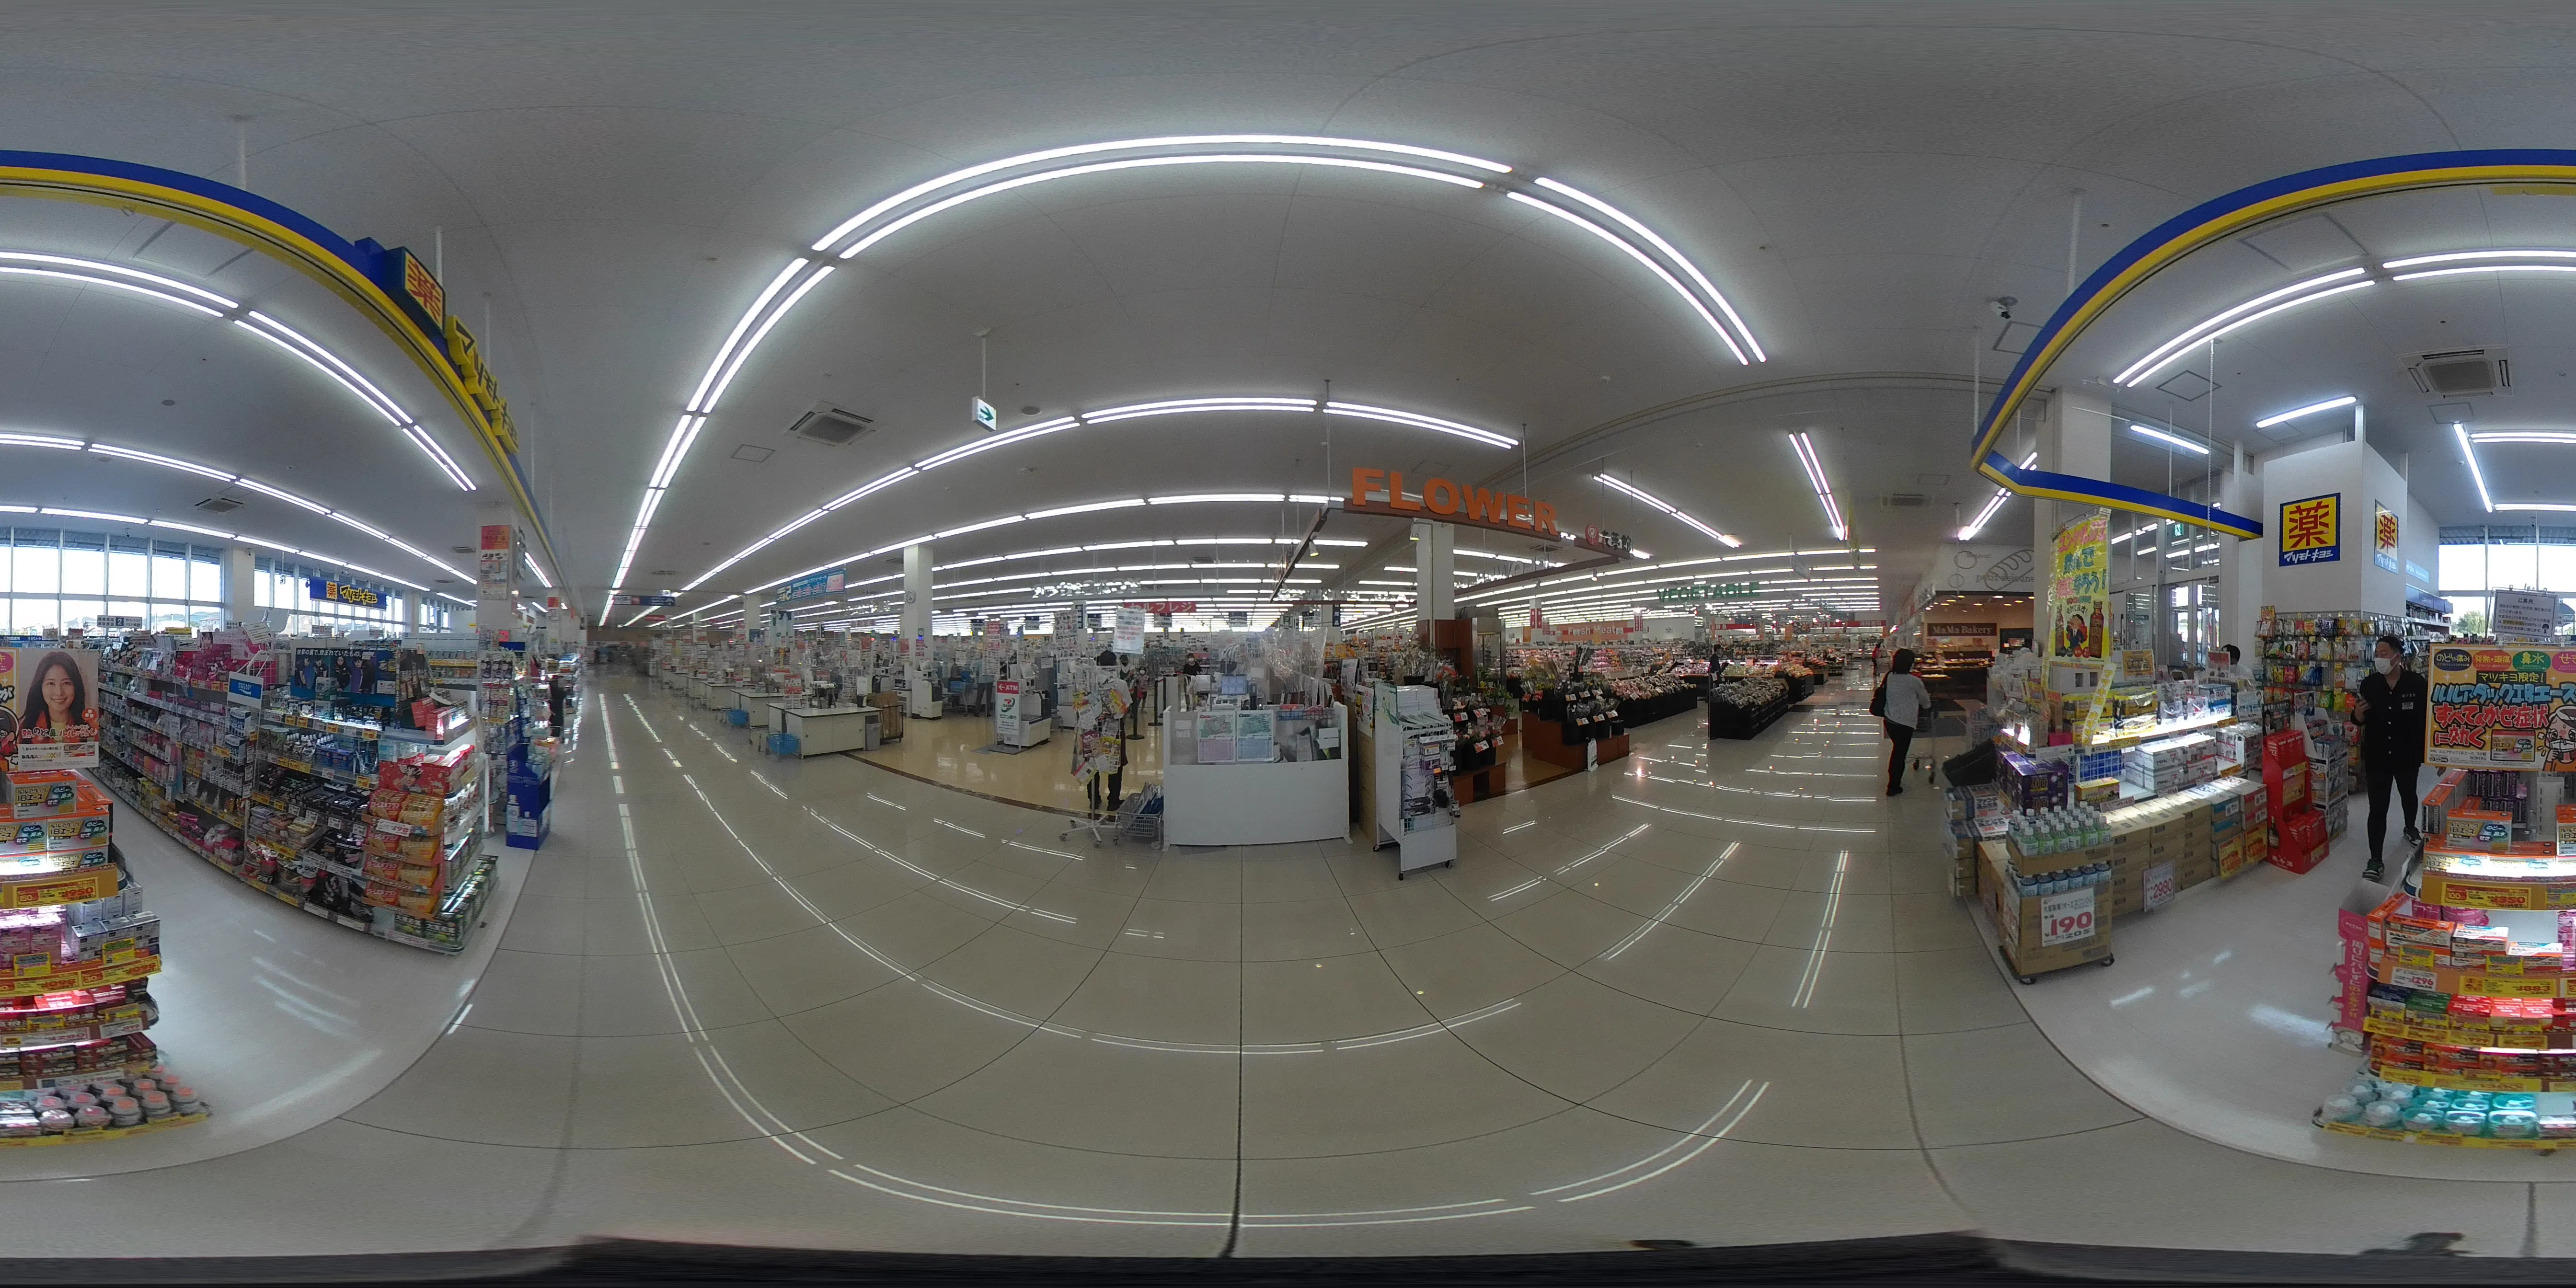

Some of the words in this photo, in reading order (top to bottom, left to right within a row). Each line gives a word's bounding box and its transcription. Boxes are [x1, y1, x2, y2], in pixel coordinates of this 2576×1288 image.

[1352, 467, 1559, 536] FLOWER
[2289, 501, 2329, 549] 薬
[2379, 514, 2395, 553] 薬
[2284, 549, 2334, 564] マツモトキヨシ
[327, 583, 336, 598] 薬
[340, 585, 377, 605] マツモトキヨシ
[1658, 582, 1760, 602] VEGETABLE
[1961, 625, 1993, 635] Bakery
[2437, 653, 2470, 662] のどの痛み
[2522, 652, 2544, 664] 鼻水
[2479, 672, 2544, 683] マツキヨ限定!
[2435, 703, 2549, 728] すべてのかぜ症状
[2435, 725, 2485, 748] に効く
[2051, 912, 2092, 936] 190
